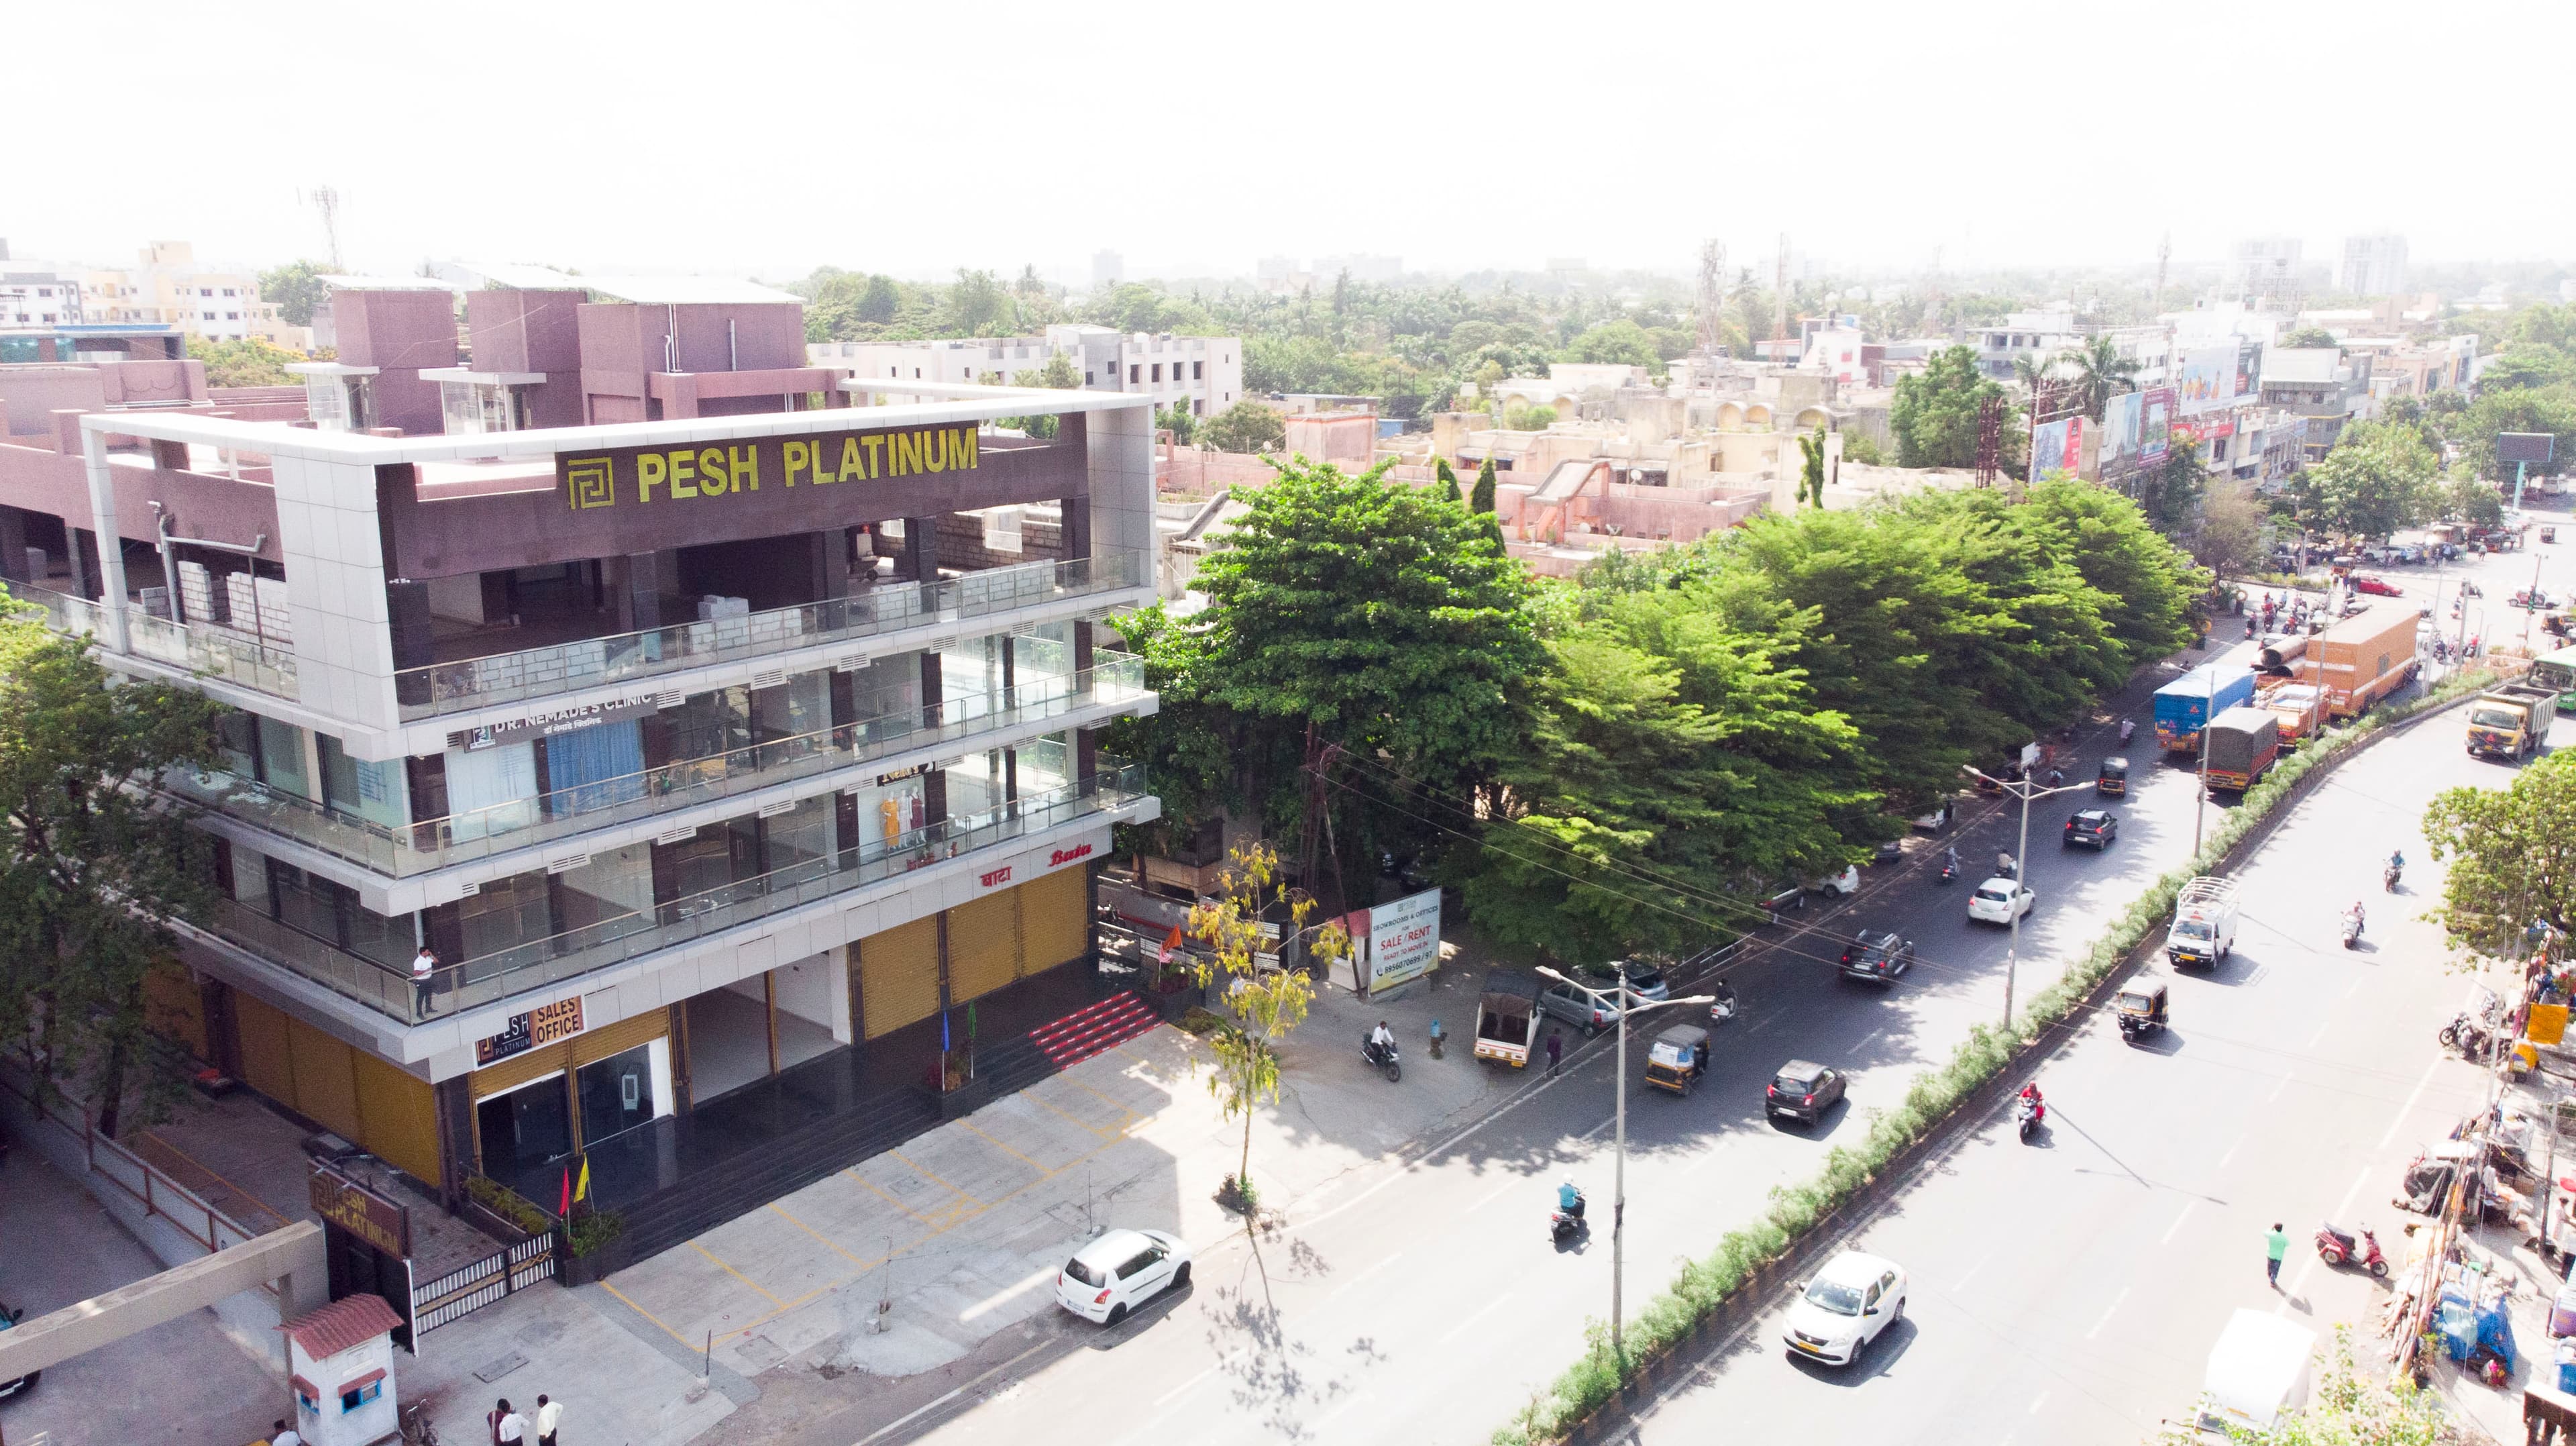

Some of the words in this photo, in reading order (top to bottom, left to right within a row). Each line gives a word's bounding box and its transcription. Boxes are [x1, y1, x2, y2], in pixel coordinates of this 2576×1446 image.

[637, 445, 759, 503] PESH
[784, 427, 978, 488] PLATINUM
[495, 721, 521, 733] DR.
[604, 695, 651, 711] CLINIC
[1048, 843, 1093, 867] Bata
[979, 866, 1012, 887] बाटा
[538, 997, 575, 1023] SALES
[537, 1014, 580, 1043] OFFICE
[495, 1037, 531, 1055] PLATINUM
